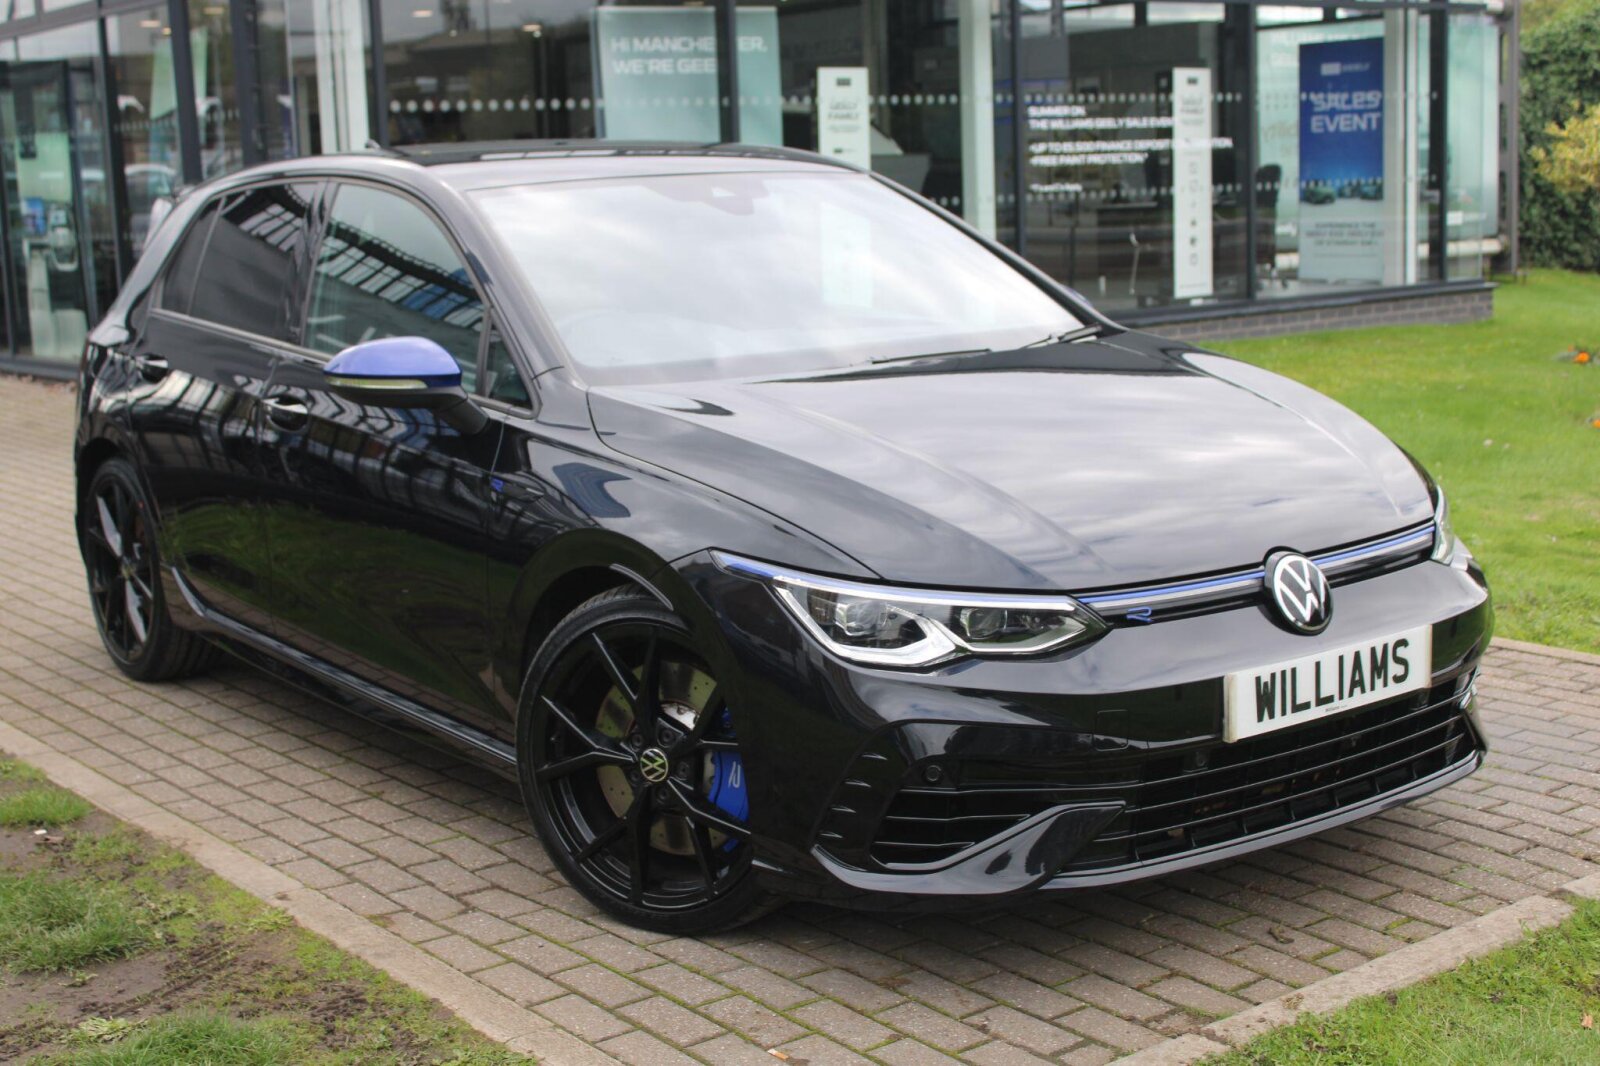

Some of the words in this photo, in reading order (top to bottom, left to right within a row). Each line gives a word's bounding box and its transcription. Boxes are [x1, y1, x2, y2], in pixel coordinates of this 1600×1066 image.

[611, 36, 629, 51] HI
[632, 35, 769, 52] MANCHEER.
[1308, 89, 1382, 112] SALES
[1310, 112, 1381, 133] EVENT
[1255, 638, 1409, 724] WILLIAMS
